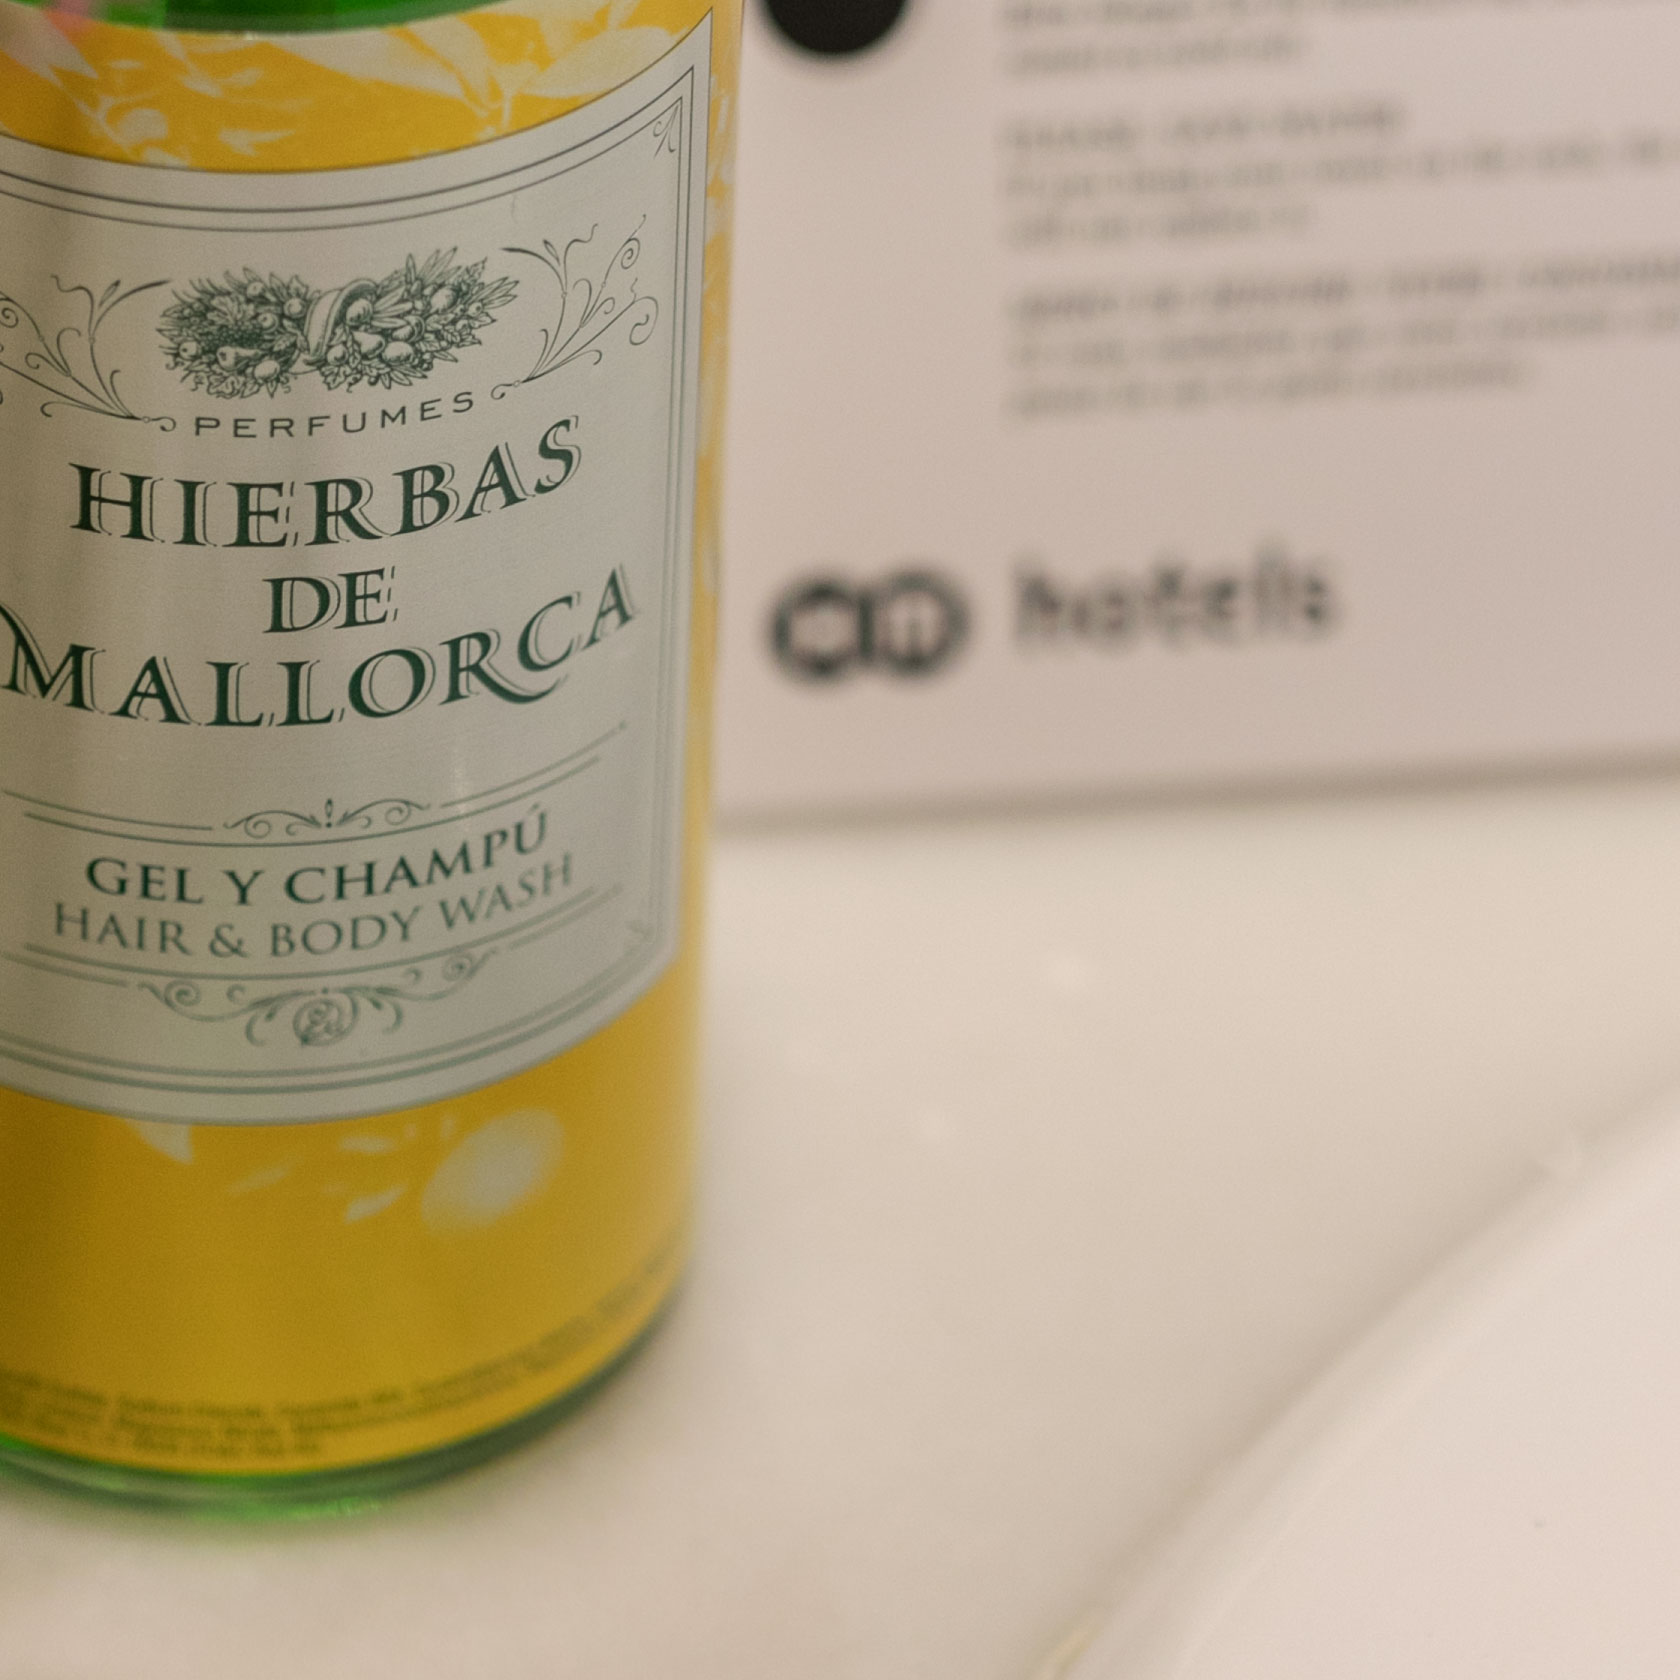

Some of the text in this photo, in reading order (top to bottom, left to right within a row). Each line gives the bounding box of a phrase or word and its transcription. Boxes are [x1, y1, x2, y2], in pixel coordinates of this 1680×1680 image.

[193, 390, 476, 439] PERFUMES
[68, 414, 583, 549] HIERBAS
[262, 564, 400, 635] DE
[53, 851, 574, 960] HAIR & BODY WASH
[84, 803, 549, 908] GEL Y CHAMPÚ
